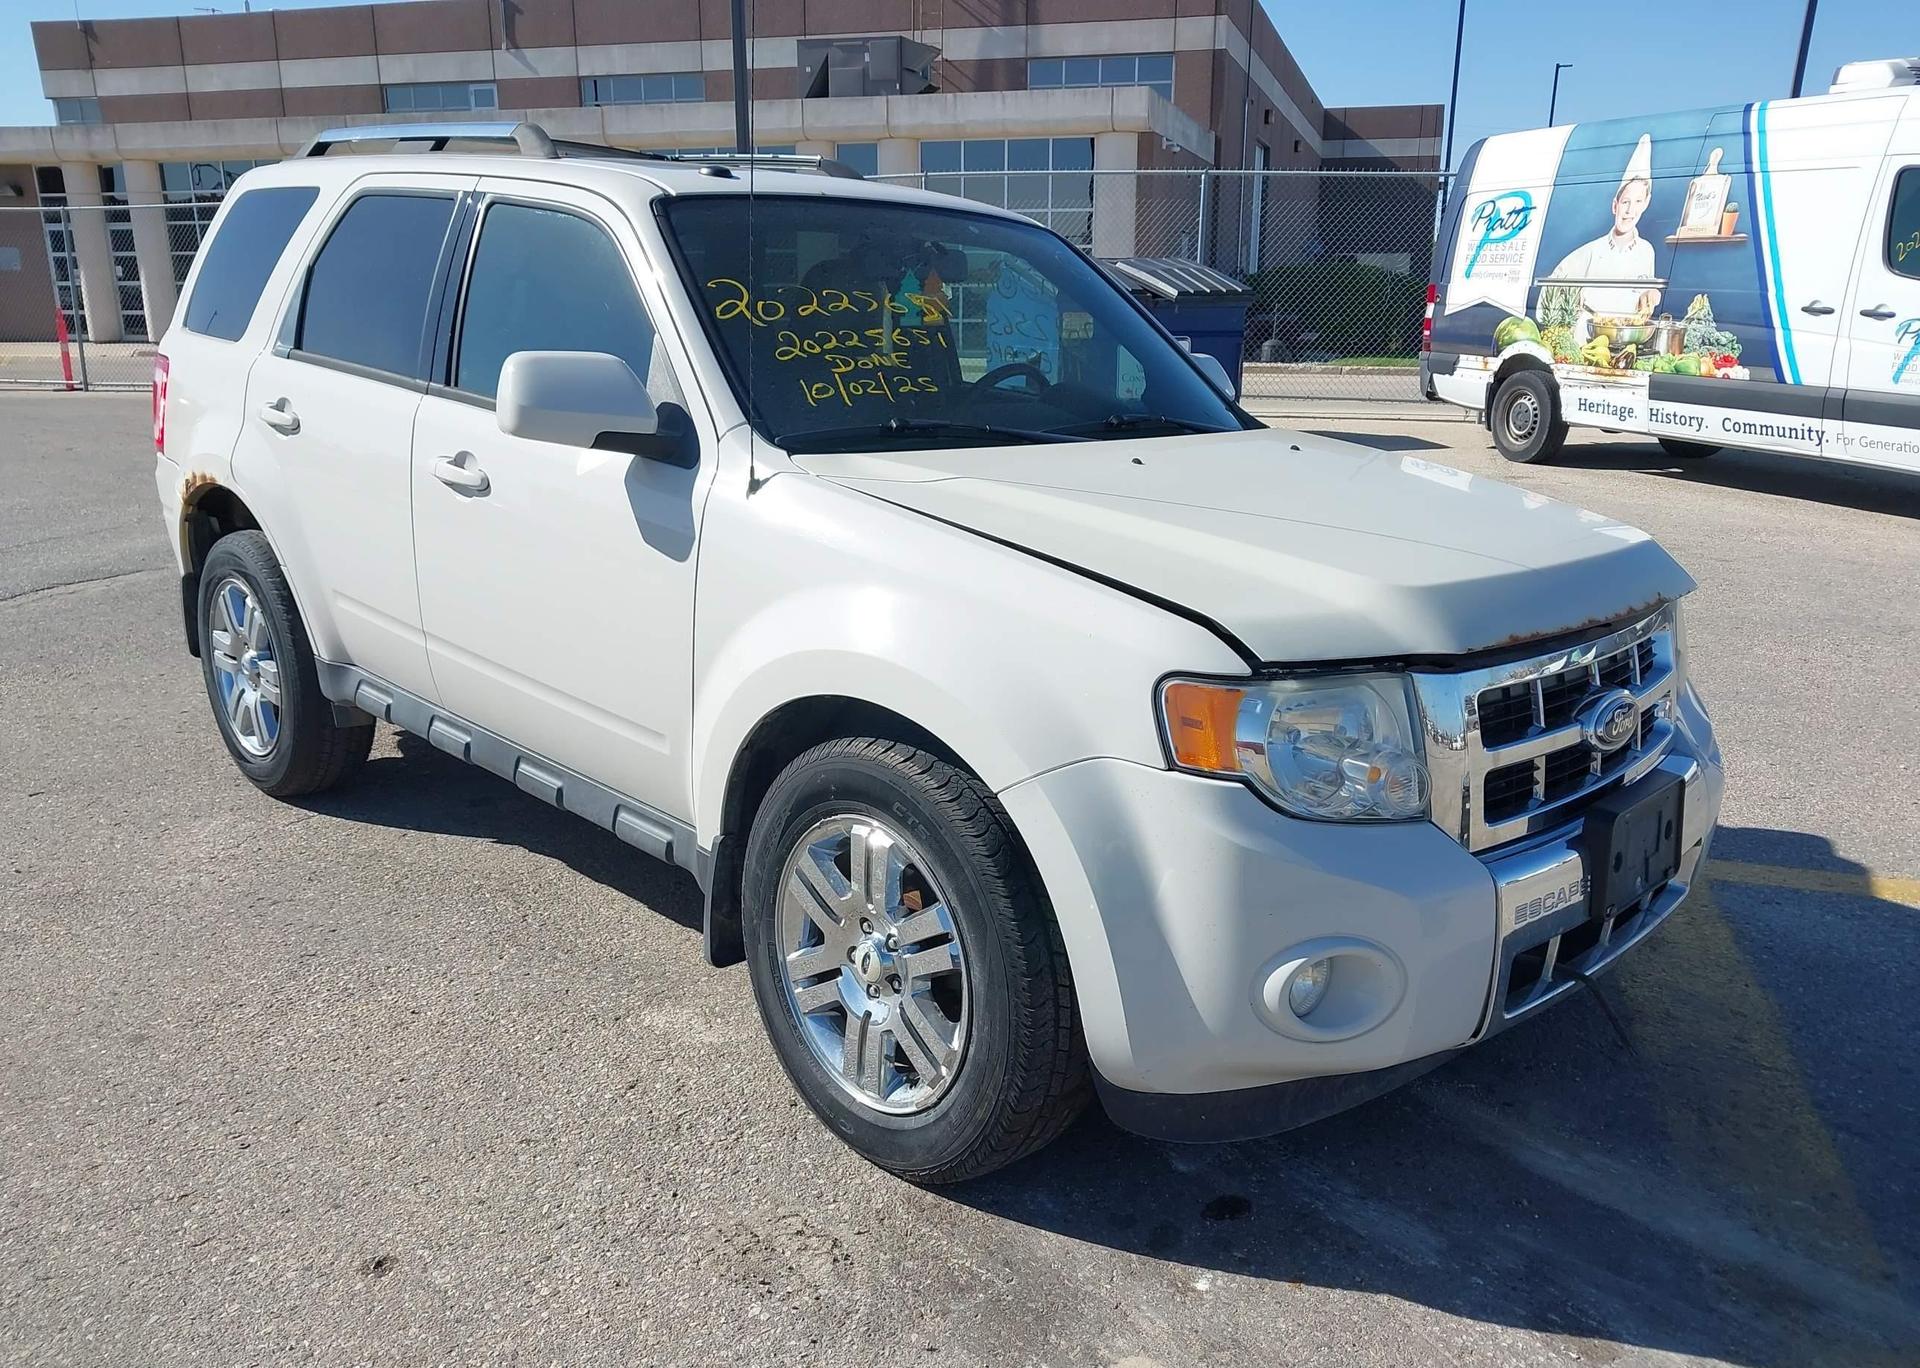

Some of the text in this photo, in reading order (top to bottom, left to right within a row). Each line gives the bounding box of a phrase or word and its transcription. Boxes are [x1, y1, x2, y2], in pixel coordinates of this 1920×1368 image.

[1489, 252, 1525, 264] SERVICE
[774, 328, 948, 360] 20225651
[824, 352, 912, 373] DONE
[800, 372, 938, 407] 10/02/25
[1578, 397, 1638, 422] Heritage.
[1649, 407, 1709, 432] History.
[1722, 417, 1829, 447] Community.
[1836, 433, 1855, 446] For
[1612, 707, 1634, 735] Ford
